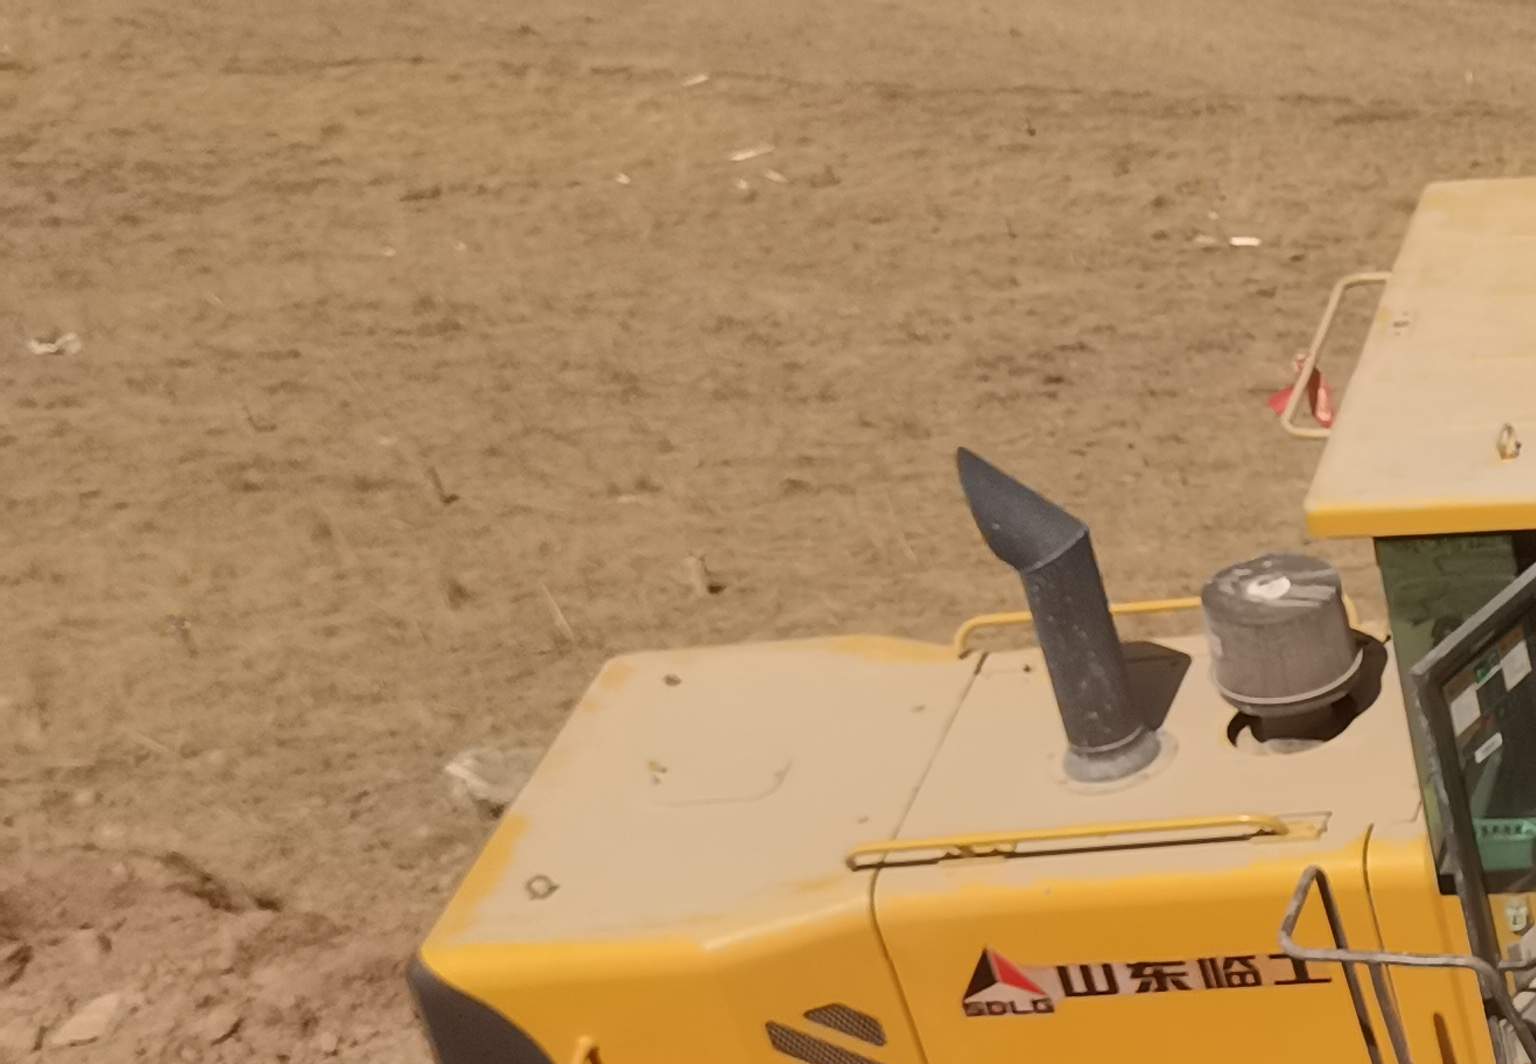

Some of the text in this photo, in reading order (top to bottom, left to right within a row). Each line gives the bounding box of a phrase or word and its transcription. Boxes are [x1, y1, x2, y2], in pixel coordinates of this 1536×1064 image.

[1056, 954, 1332, 998] 山东临工
[963, 999, 1054, 1016] SDLG
